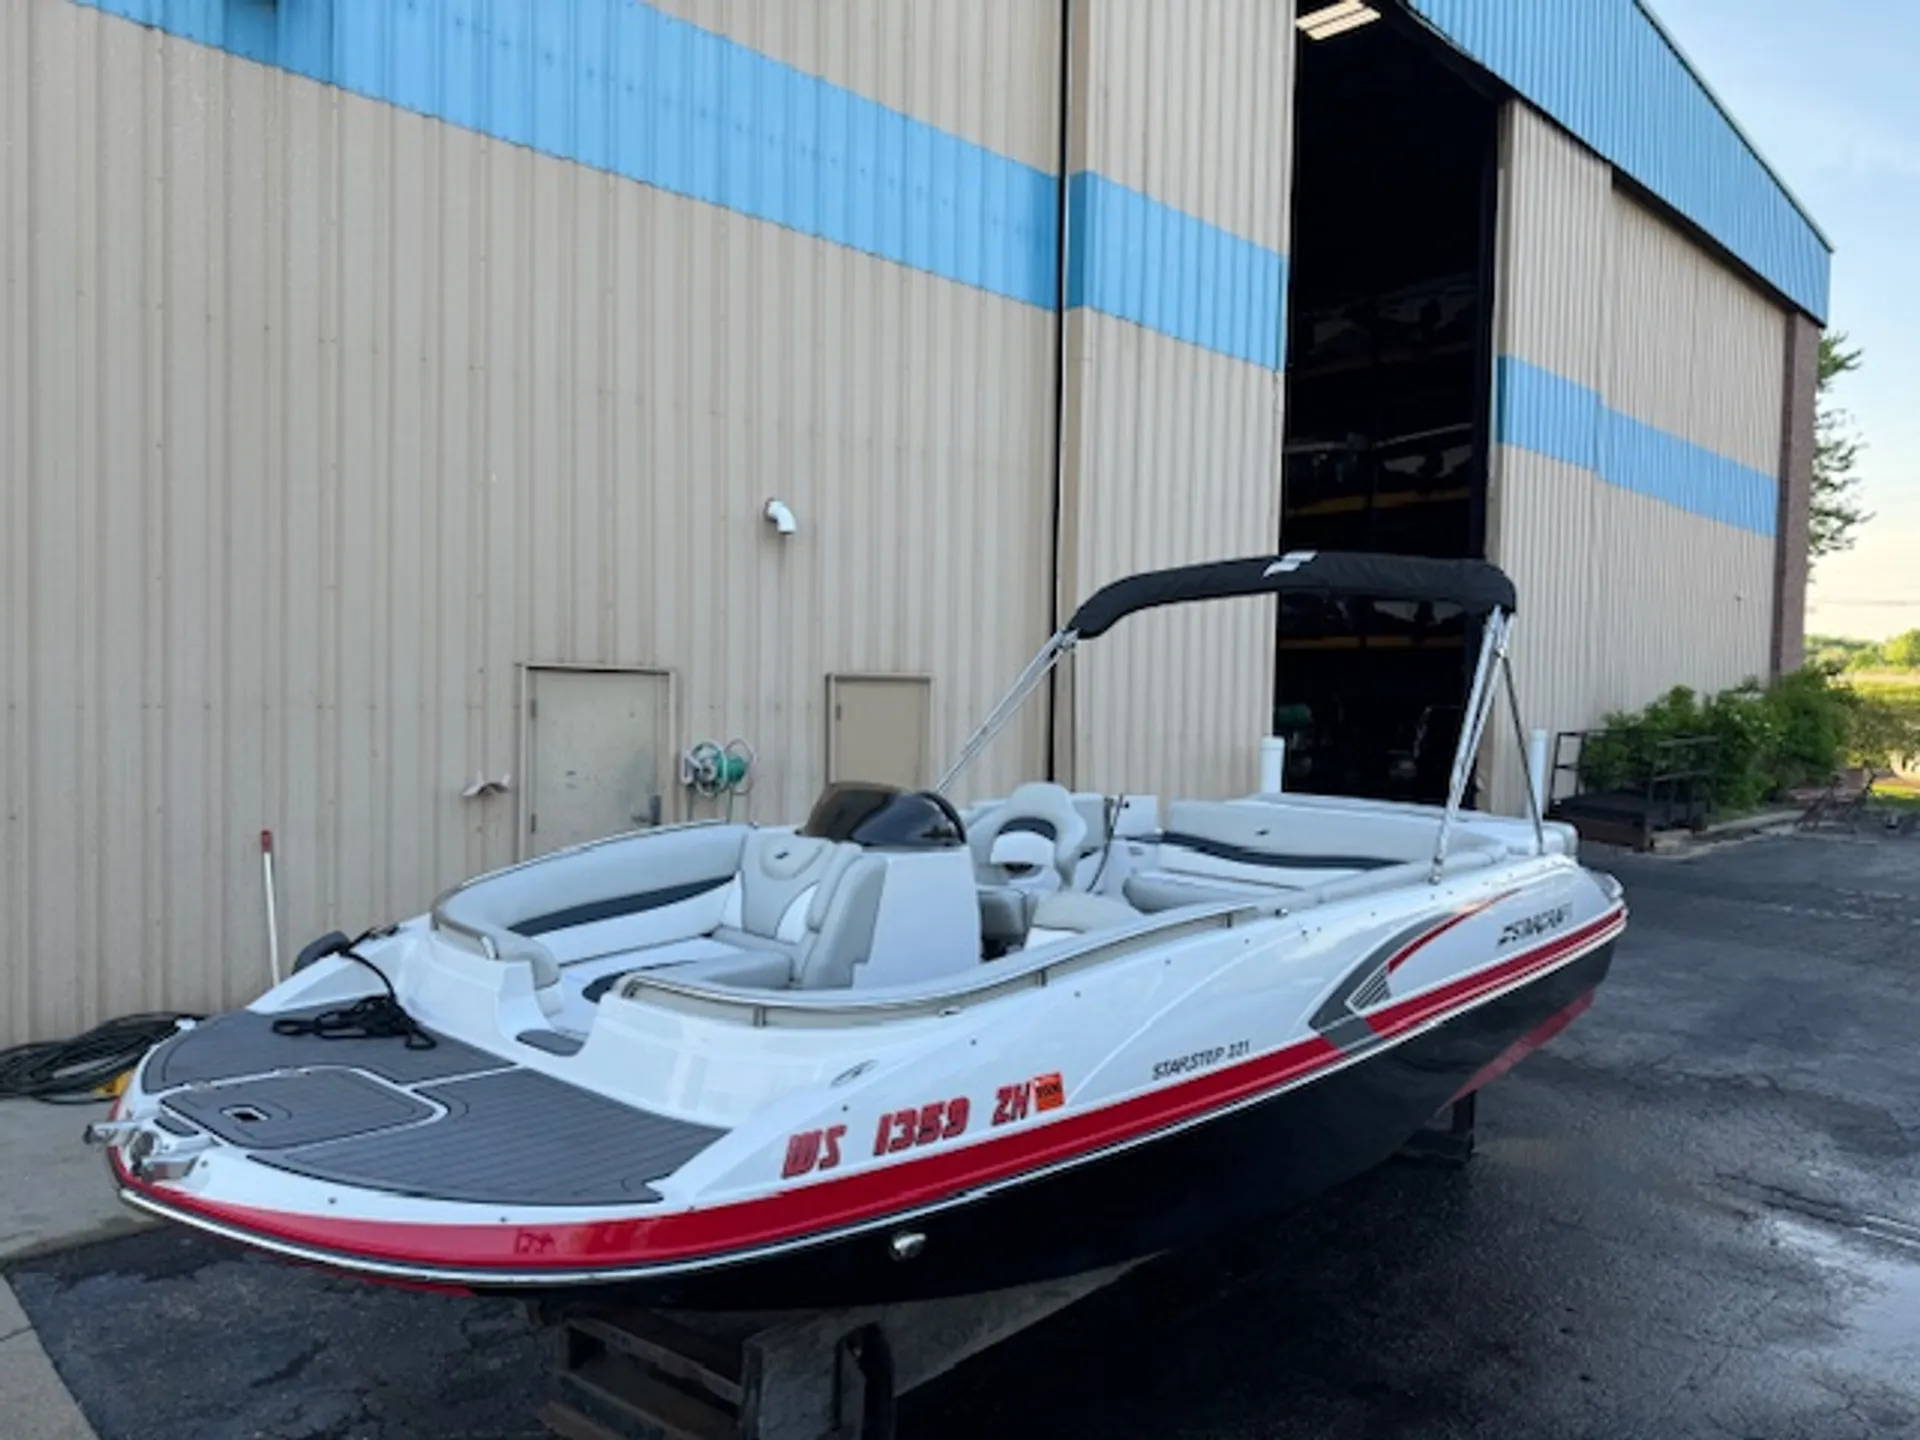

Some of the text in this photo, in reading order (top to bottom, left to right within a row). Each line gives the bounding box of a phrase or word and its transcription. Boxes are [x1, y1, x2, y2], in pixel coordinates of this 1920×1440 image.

[781, 1081, 1030, 1179] WS 1359 ZH
